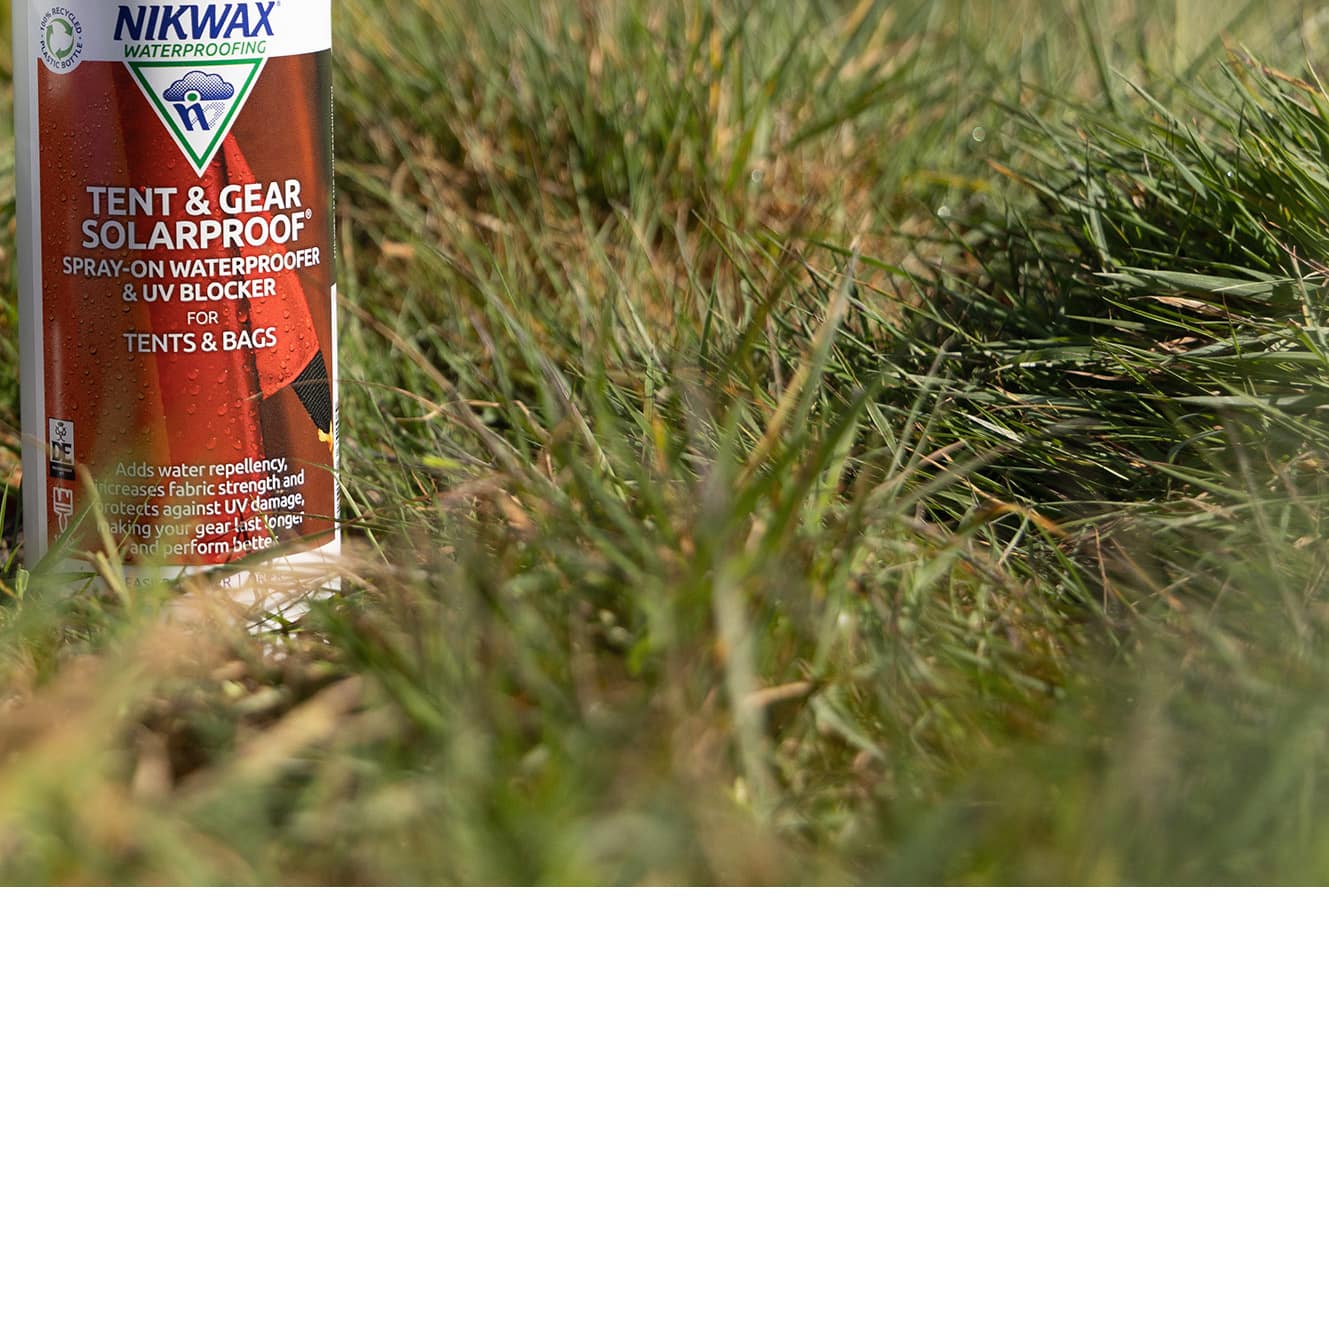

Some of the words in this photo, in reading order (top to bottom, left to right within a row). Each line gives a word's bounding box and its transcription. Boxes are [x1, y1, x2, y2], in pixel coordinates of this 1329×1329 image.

[51, 6, 83, 34] RECYCLED
[113, 1, 275, 41] NIKWAX
[60, 42, 83, 69] BOTTLE
[124, 40, 267, 58] WATERPROOFING
[86, 186, 178, 216] TENT
[185, 186, 211, 215] &
[219, 179, 301, 213] GEAR
[63, 256, 164, 278] SPRAY-ON
[170, 246, 320, 277] WATERPROOFER
[122, 284, 138, 302] &
[142, 284, 174, 302] UV
[180, 278, 276, 301] BLOCKER
[187, 311, 218, 325] FOR
[123, 332, 196, 353] TENTS
[201, 332, 218, 351] &
[222, 327, 277, 350] BAGS
[115, 462, 154, 478] Adds
[158, 463, 206, 478] water
[209, 457, 288, 479] repellency,
[168, 481, 215, 497] fabric
[218, 474, 281, 495] strength
[283, 468, 304, 487] and
[162, 500, 221, 519] against
[225, 498, 248, 513] UV
[250, 493, 305, 512] damage,
[99, 519, 151, 539] aking
[154, 524, 192, 539] your
[195, 522, 231, 539] gear
[130, 540, 159, 554] and
[163, 539, 229, 559] perform
